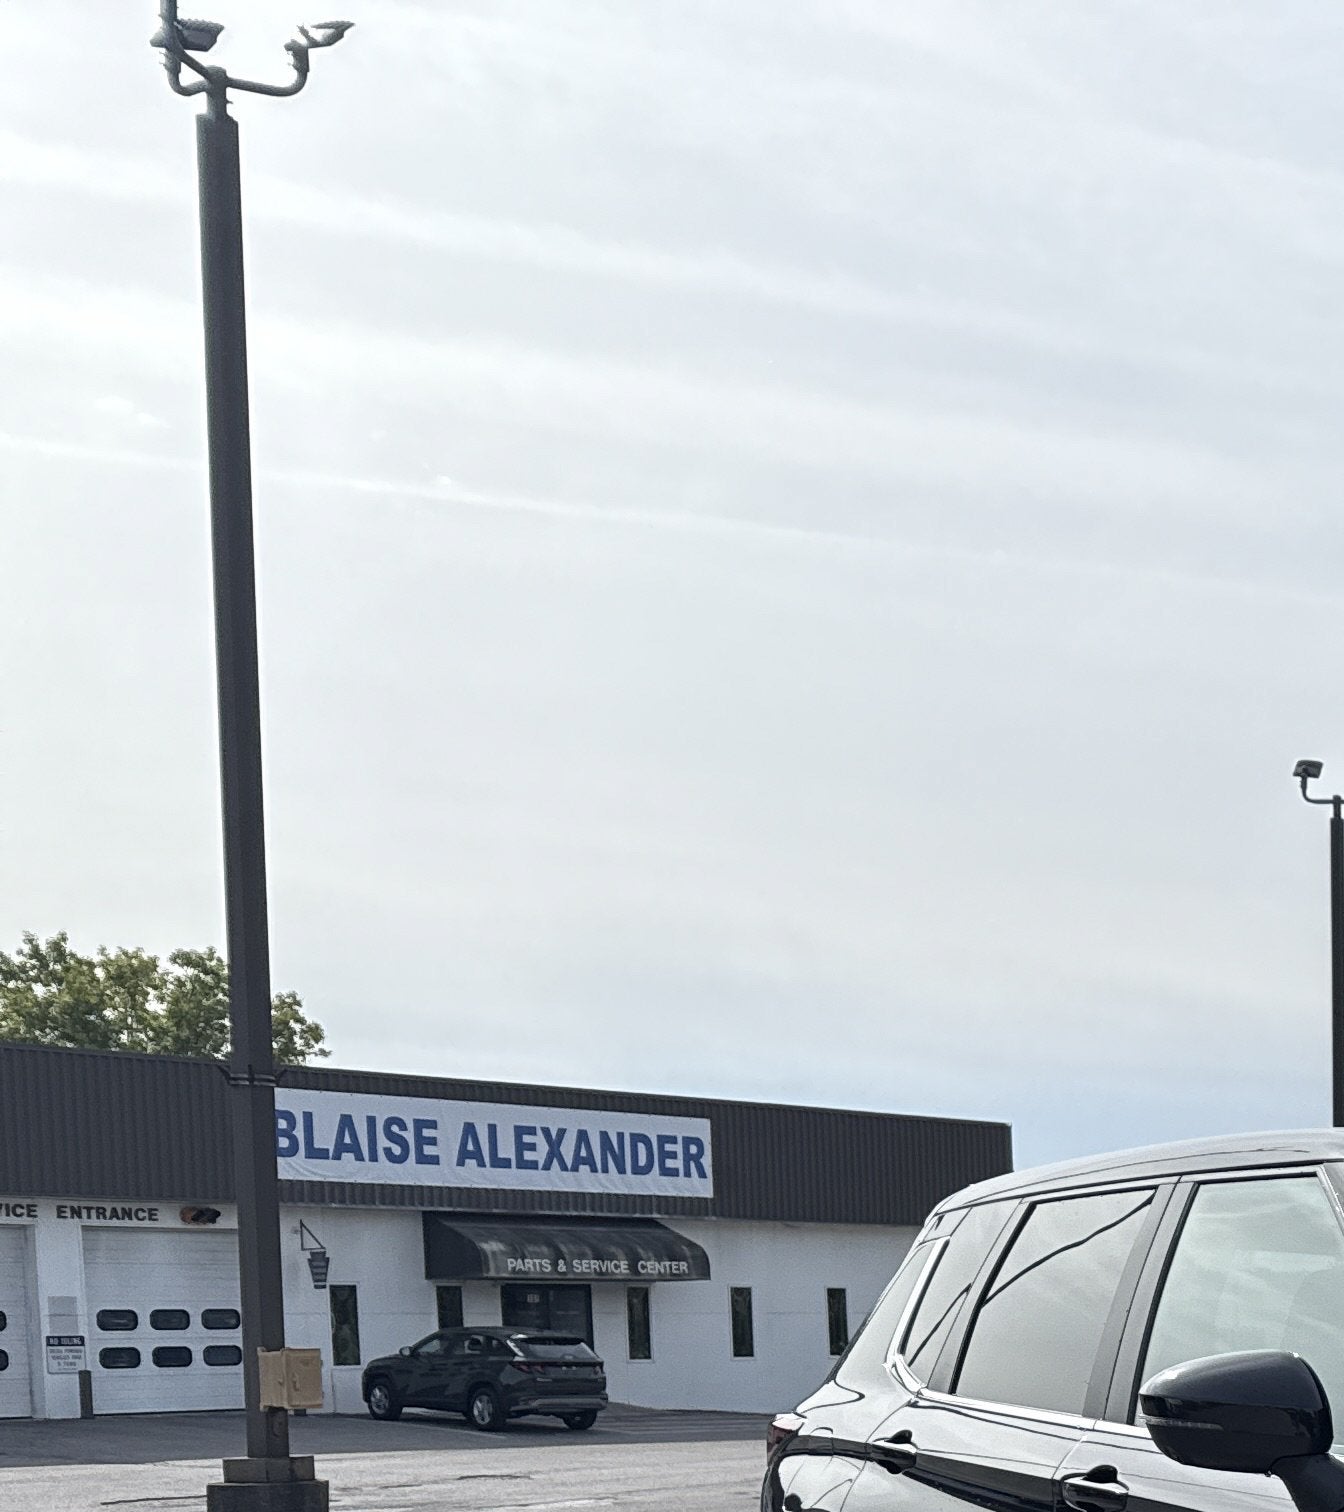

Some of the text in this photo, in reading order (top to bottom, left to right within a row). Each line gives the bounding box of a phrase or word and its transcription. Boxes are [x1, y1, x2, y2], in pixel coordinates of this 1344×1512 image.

[274, 1109, 708, 1179] BLAISE ALEXANDER
[56, 1204, 160, 1222] ENTRANCE
[506, 1258, 689, 1275] PARTS & SERVICE CENTER
